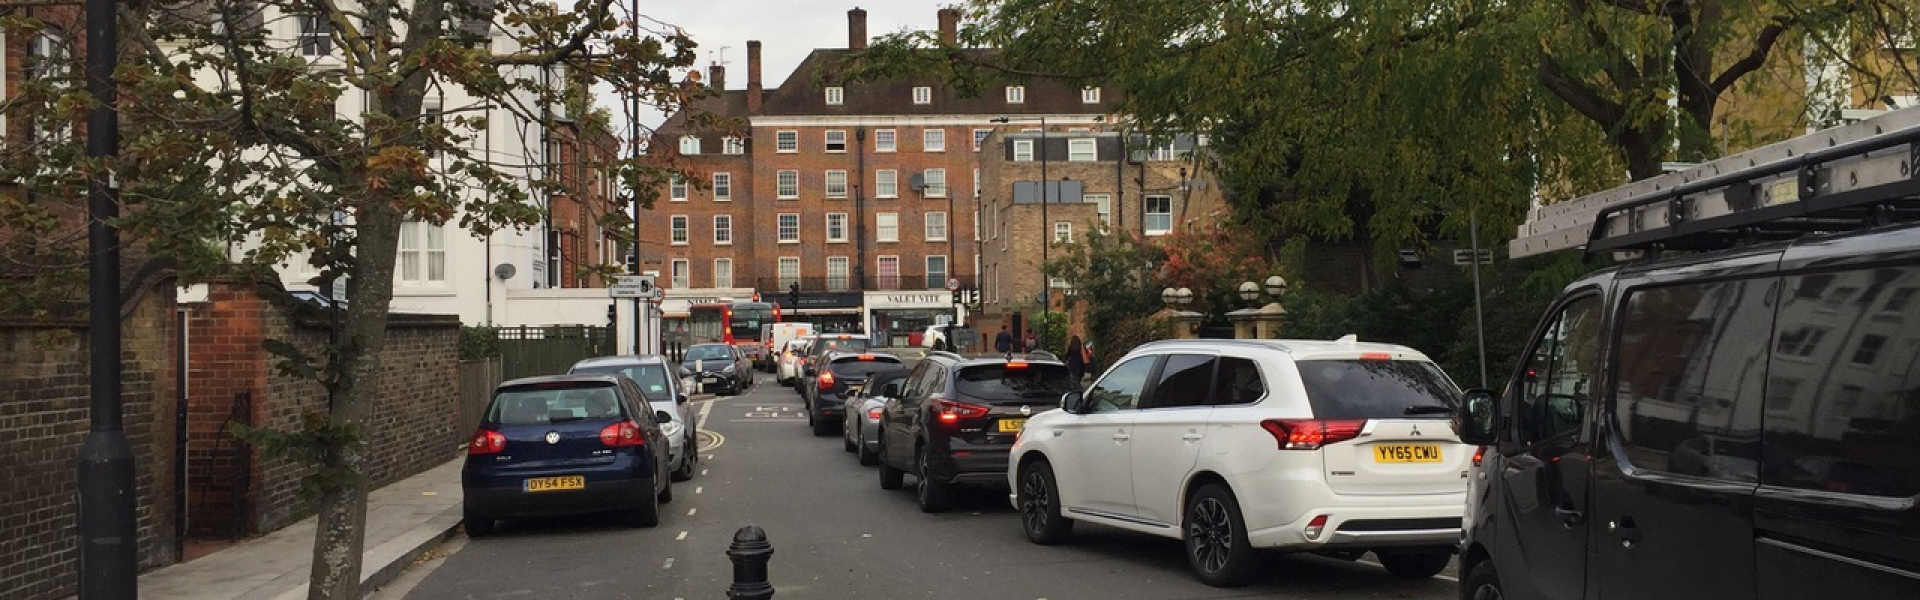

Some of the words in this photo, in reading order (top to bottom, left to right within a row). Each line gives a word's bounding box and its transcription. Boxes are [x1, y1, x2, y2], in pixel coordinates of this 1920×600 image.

[887, 295, 916, 303] VALET
[1380, 446, 1412, 460] YY65
[1413, 446, 1438, 460] CWU
[560, 475, 583, 487] FSX
